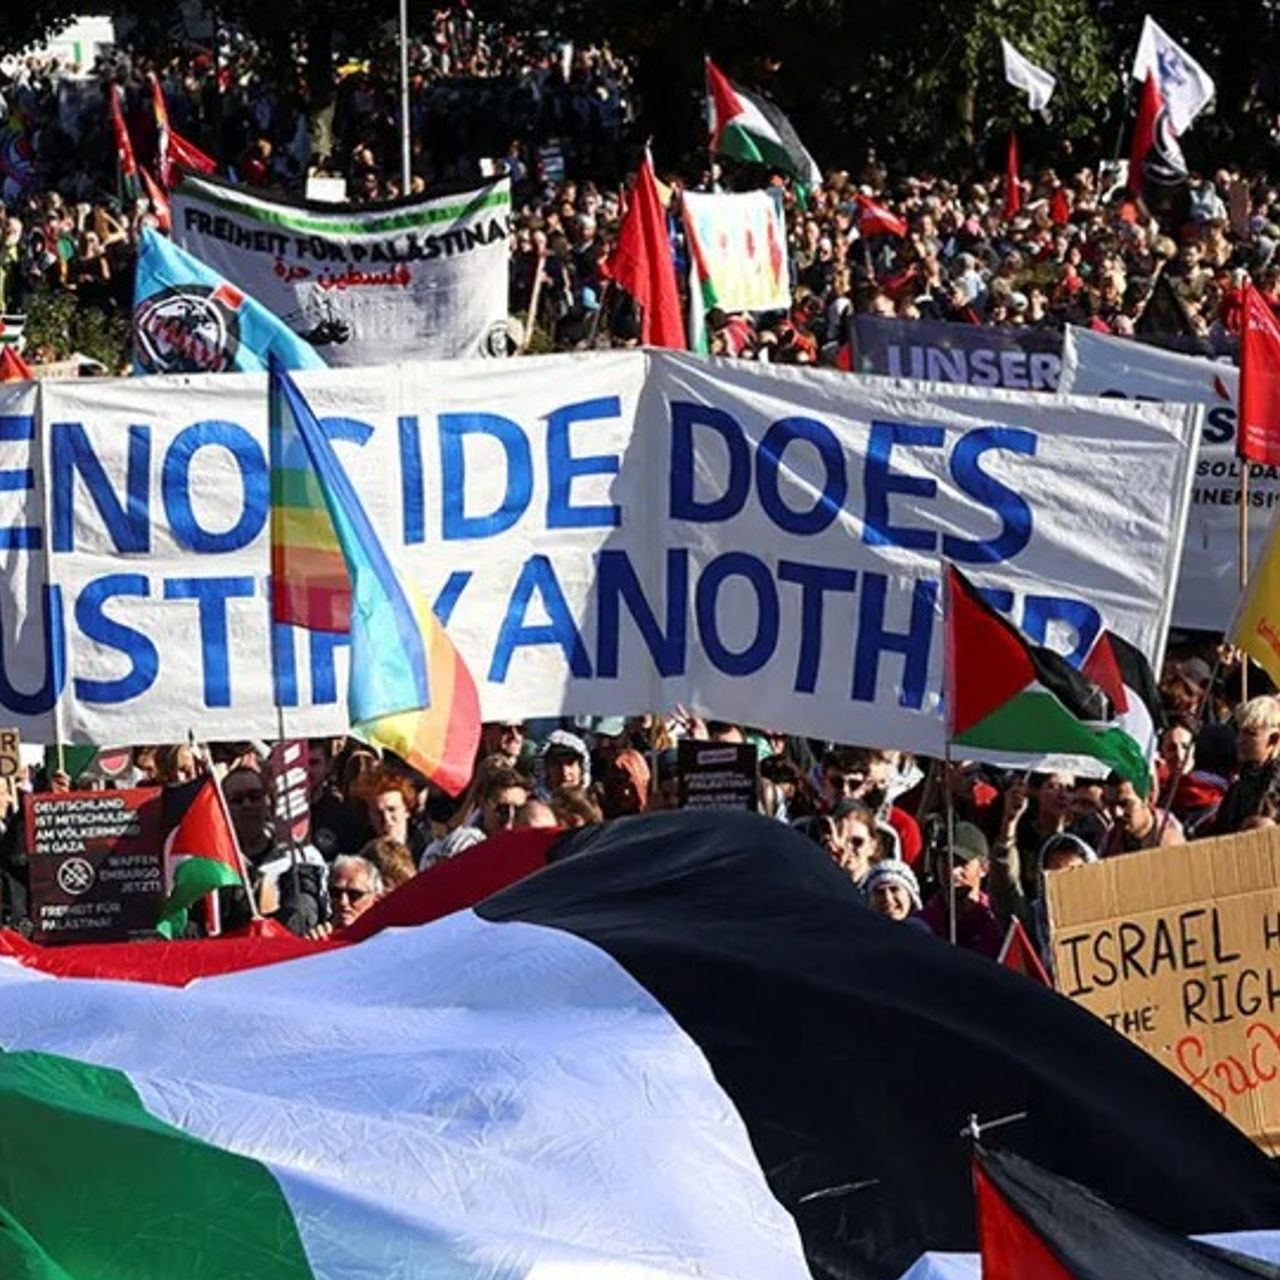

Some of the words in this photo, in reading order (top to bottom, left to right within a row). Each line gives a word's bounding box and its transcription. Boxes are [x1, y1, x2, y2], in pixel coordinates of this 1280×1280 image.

[185, 207, 289, 254] FREIHEIT
[296, 232, 347, 264] FÜR
[887, 345, 1062, 391] UNSER
[669, 400, 1038, 565] DOES
[34, 798, 125, 814] DEUTSCHLAND
[35, 813, 53, 826] IST
[36, 827, 55, 841] AM
[37, 842, 51, 853] IN
[52, 841, 86, 853] GAZA
[1060, 907, 1240, 998] ISRAEL
[1105, 1004, 1157, 1035] THE
